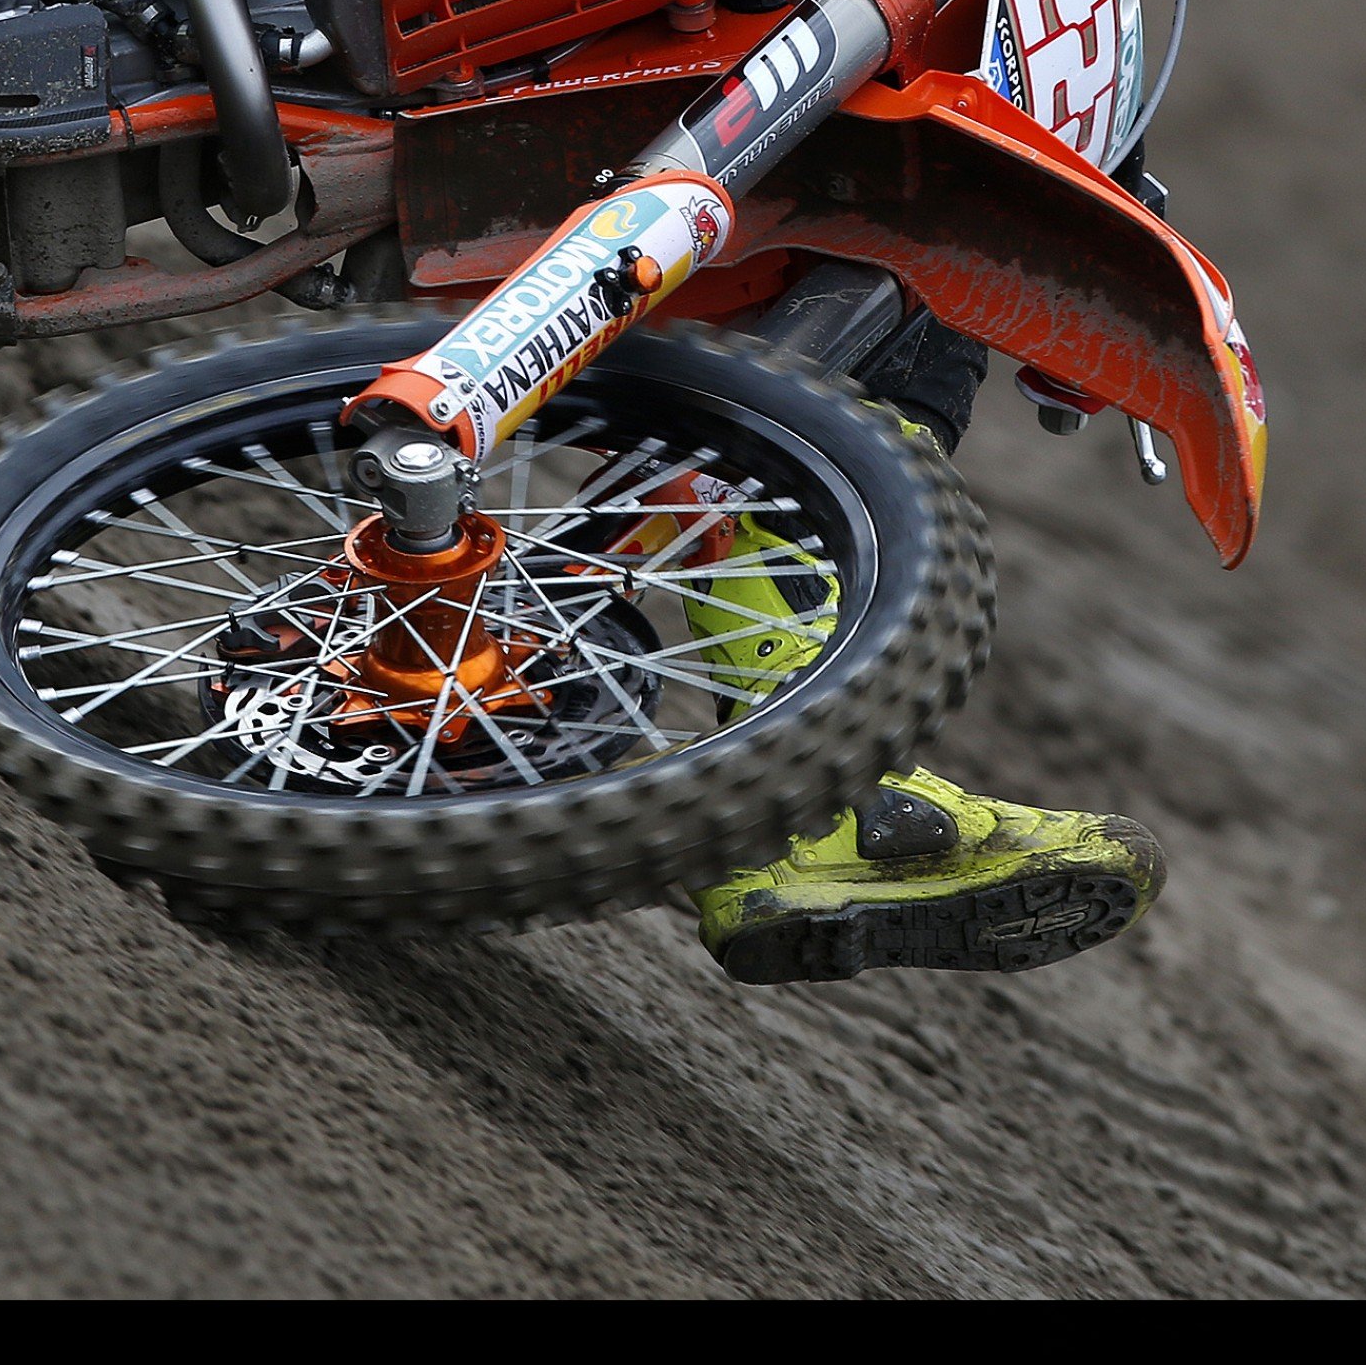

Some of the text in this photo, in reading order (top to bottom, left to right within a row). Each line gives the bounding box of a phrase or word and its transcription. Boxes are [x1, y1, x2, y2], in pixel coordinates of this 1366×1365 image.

[997, 16, 1023, 109] SCORPIO
[717, 75, 836, 188] CONE VALV
[450, 233, 611, 369] MOTOREX
[484, 295, 595, 412] ATHENA
